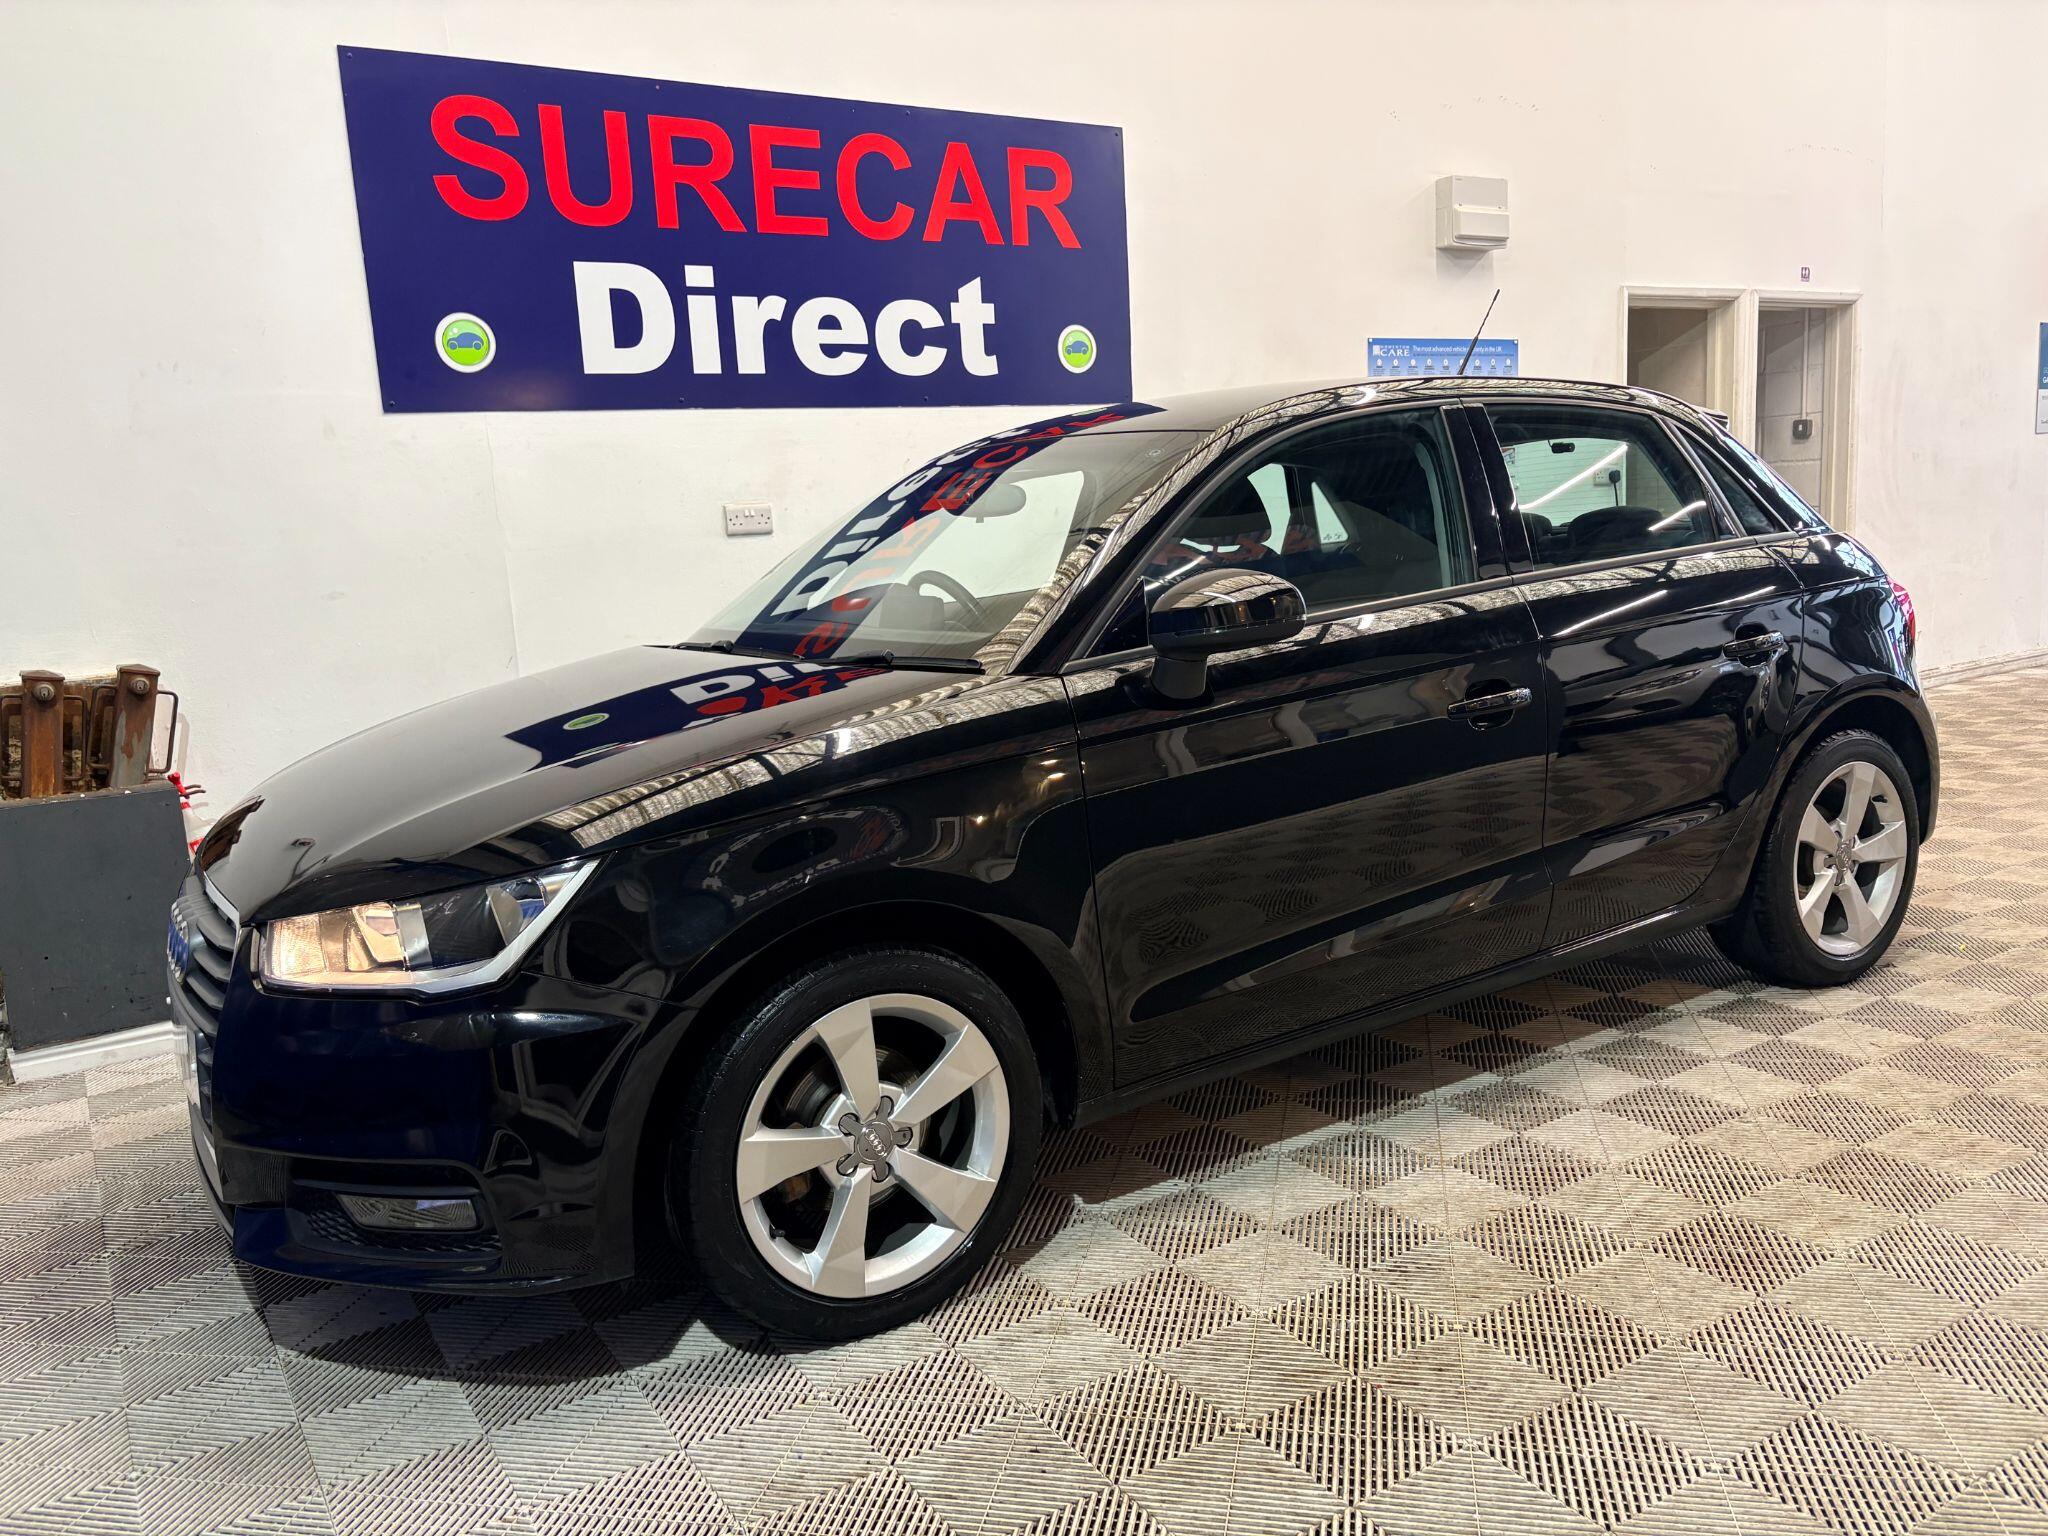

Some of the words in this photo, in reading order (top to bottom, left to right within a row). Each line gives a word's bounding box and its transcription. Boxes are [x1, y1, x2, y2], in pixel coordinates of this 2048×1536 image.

[430, 94, 1082, 249] SURECAR
[573, 261, 999, 376] Direct
[1380, 348, 1410, 357] CARE
